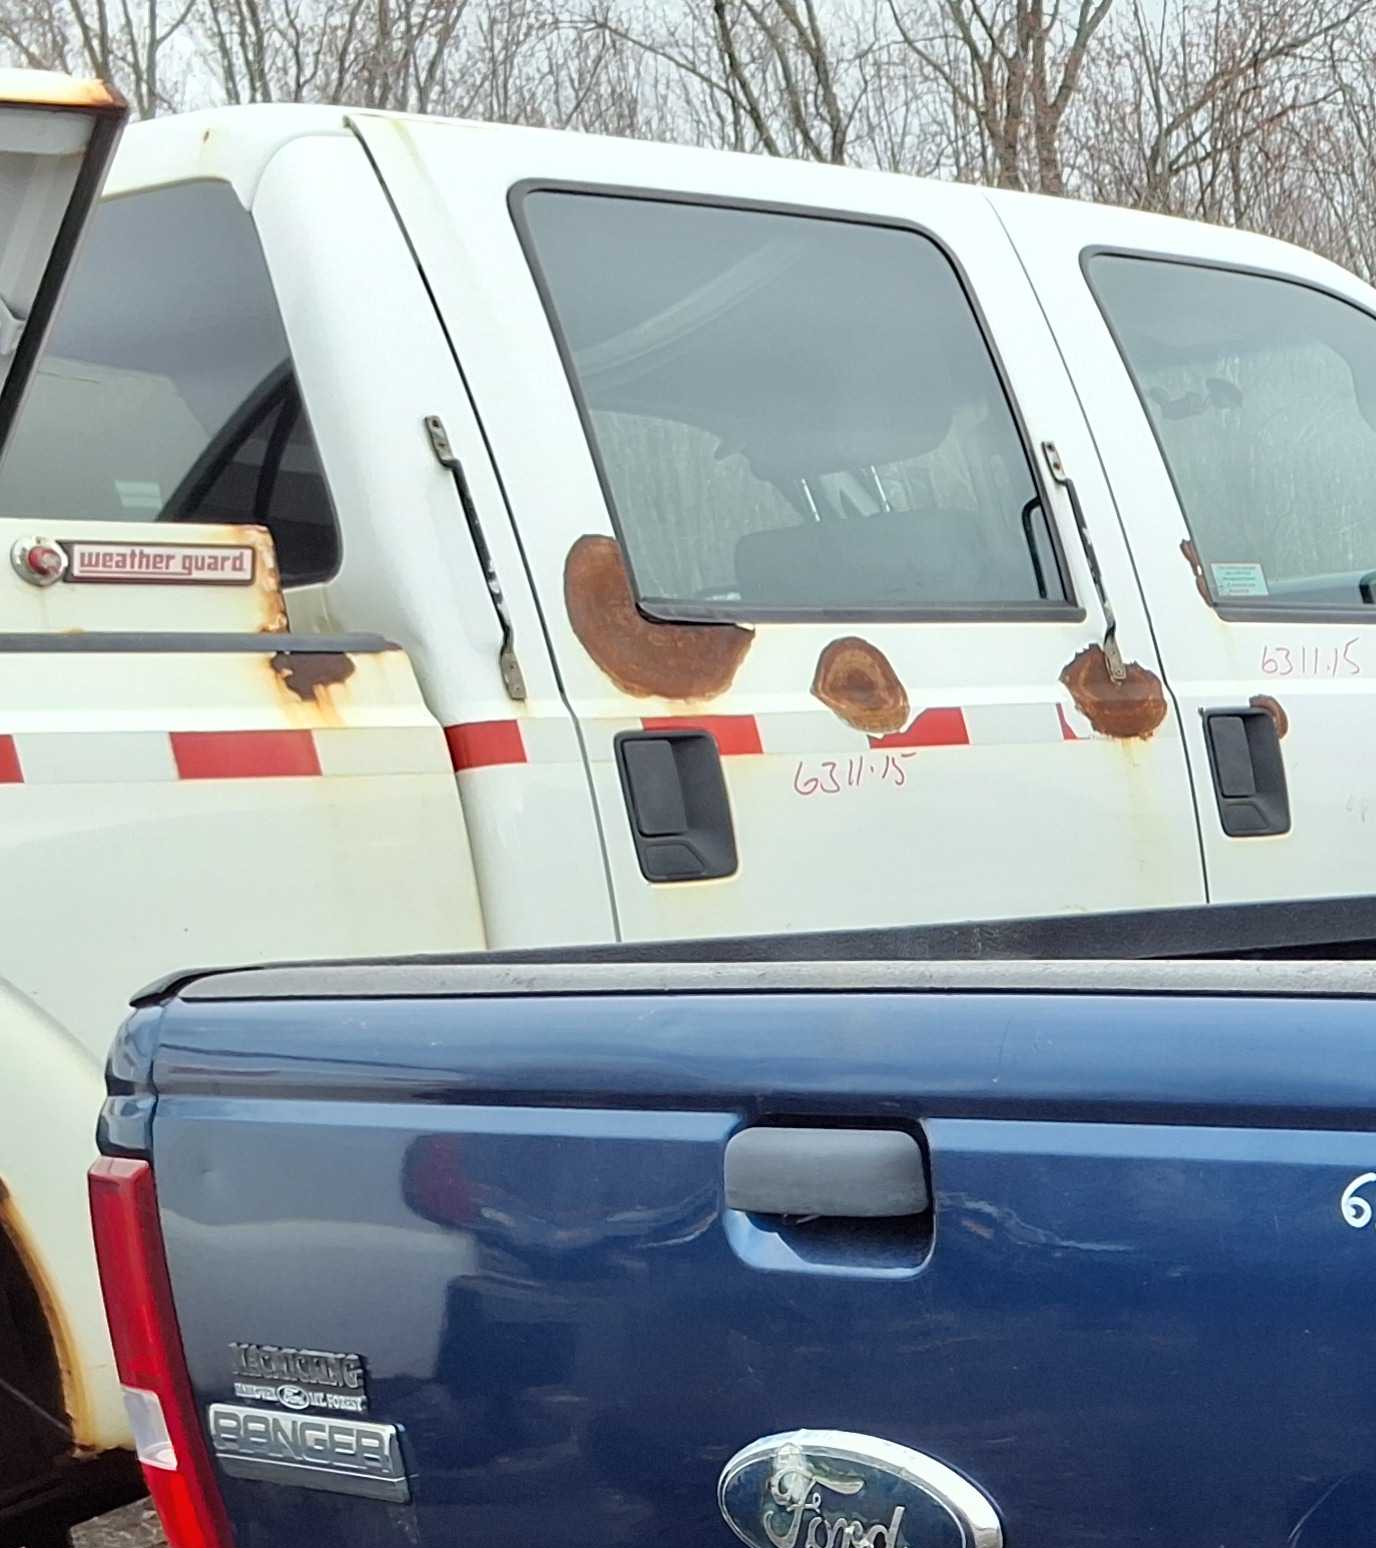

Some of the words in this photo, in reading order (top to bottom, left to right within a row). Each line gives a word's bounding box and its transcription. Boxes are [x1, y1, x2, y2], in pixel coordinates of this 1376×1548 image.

[79, 549, 175, 571] weather
[182, 551, 244, 576] guard
[212, 1410, 391, 1473] RANGER
